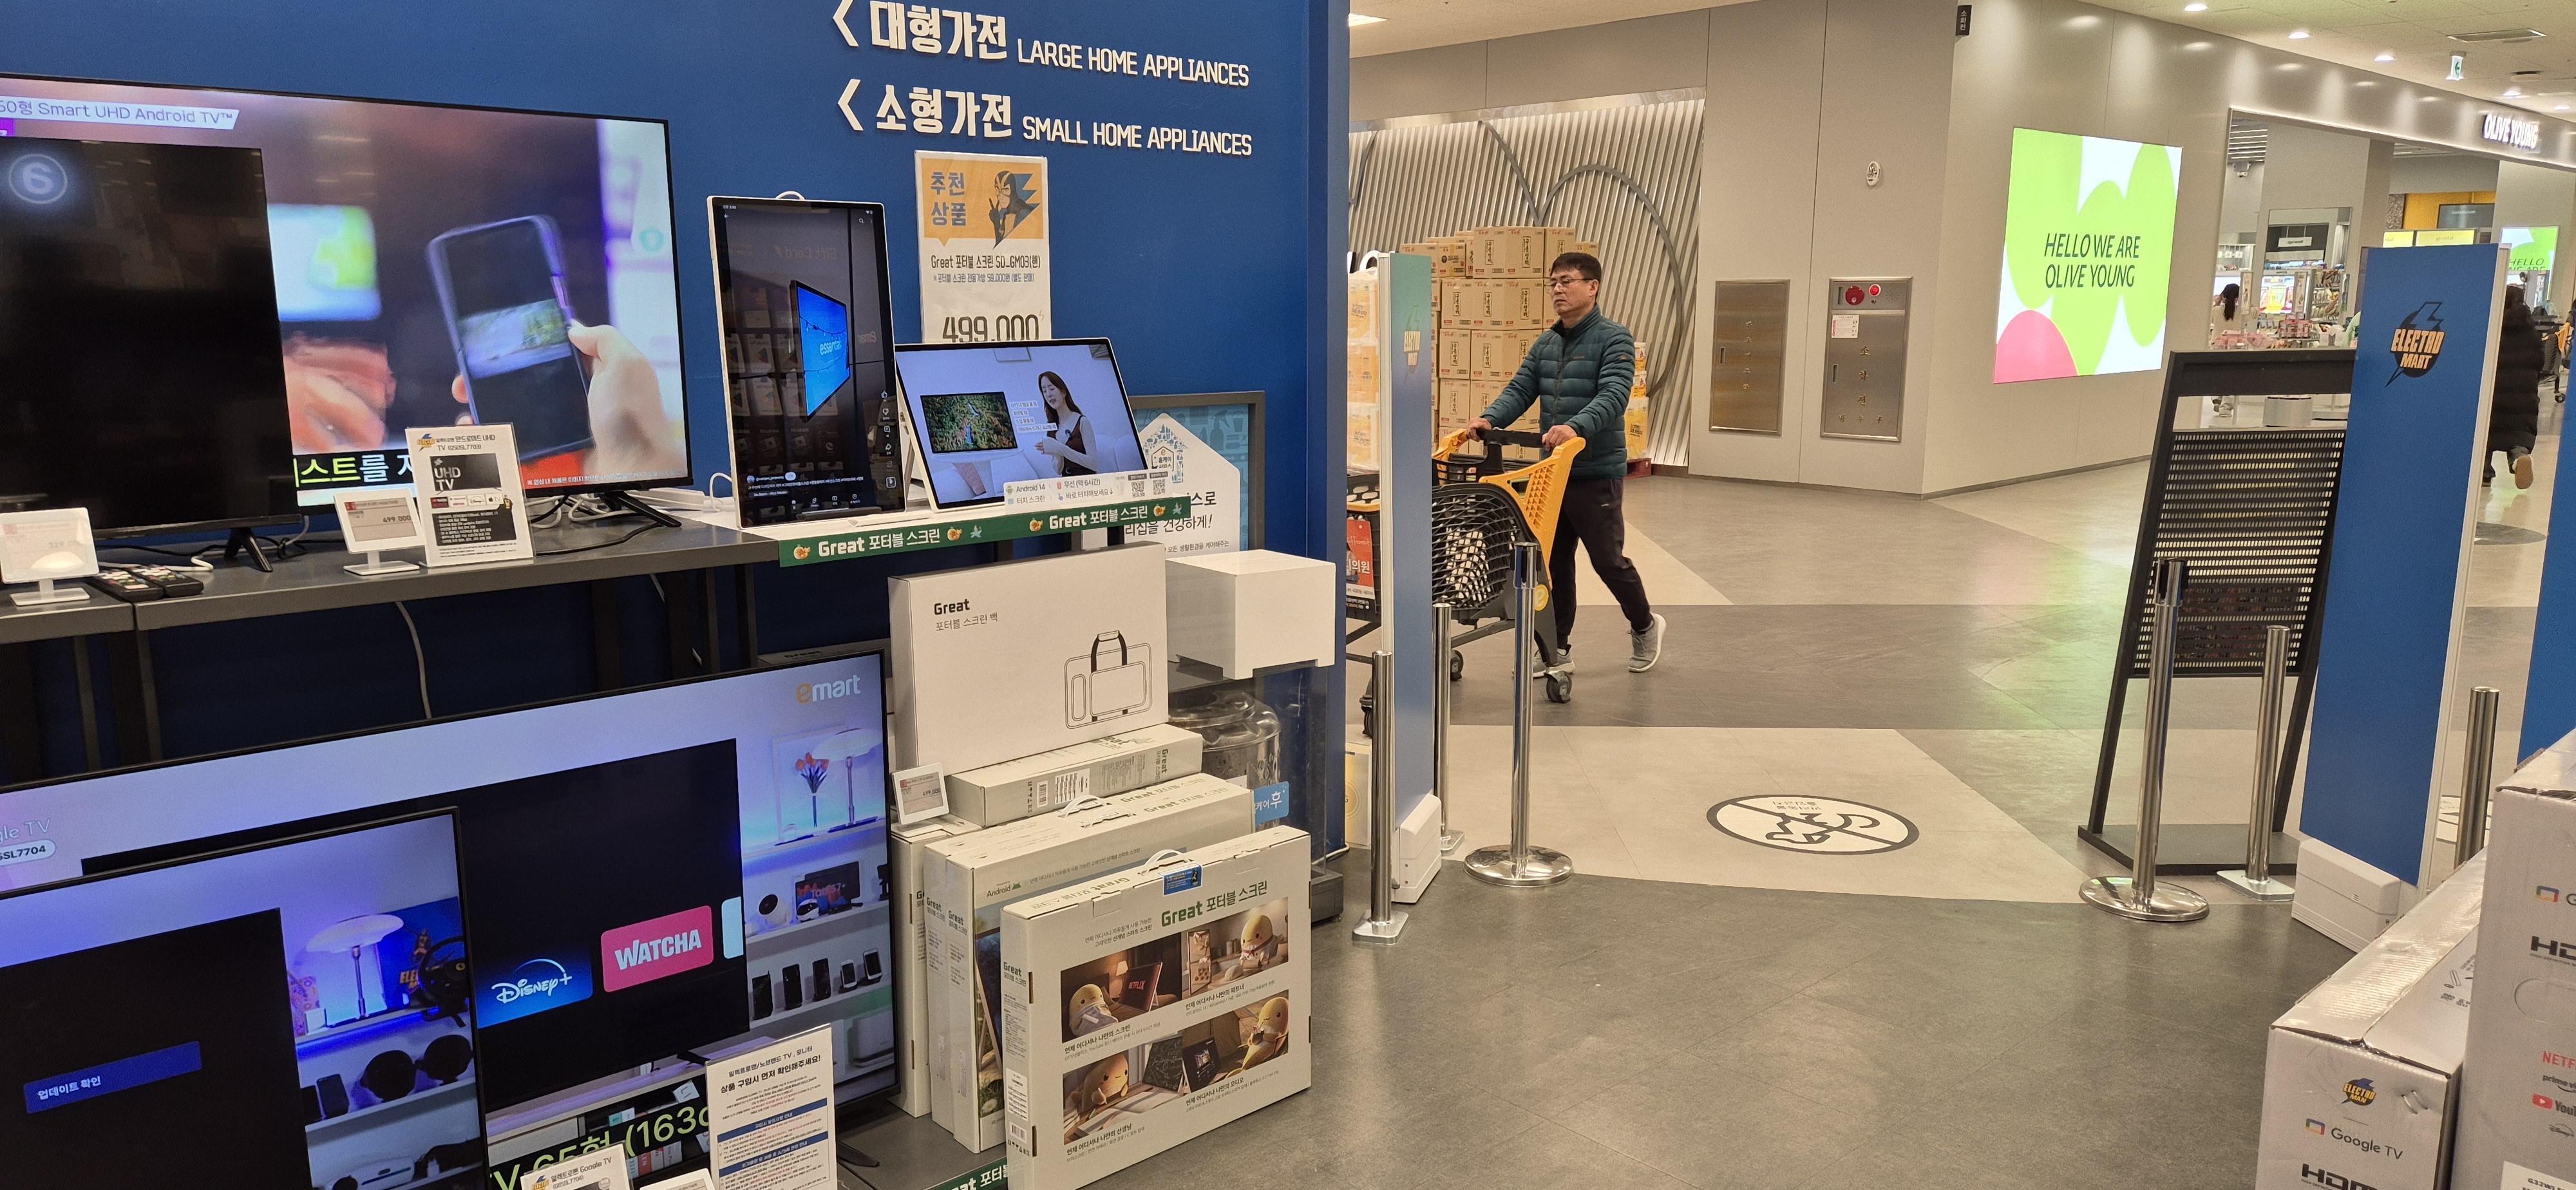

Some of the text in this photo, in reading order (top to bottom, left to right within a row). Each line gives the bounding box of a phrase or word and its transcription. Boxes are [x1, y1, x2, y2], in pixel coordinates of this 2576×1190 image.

[870, 0, 1249, 86] 대형가전 LARGE HOME APPLIANCES
[39, 102, 90, 117] Smart
[95, 106, 130, 120] UHD
[135, 108, 195, 123] Android
[876, 84, 1253, 156] 소형가전 SMALL HOME APPLIANCES
[2483, 113, 2538, 149] OLIVE YOUNG
[931, 172, 965, 196] 추천
[931, 202, 967, 227] 상품
[2044, 233, 2141, 258] HELLO WE ARE
[931, 255, 953, 269] Great
[956, 255, 974, 269] 포터블
[976, 255, 994, 269] 스크린
[2045, 264, 2135, 288] OLIVE YOUNG
[2391, 329, 2445, 354] ELECTRO
[2400, 353, 2432, 369] MART
[294, 454, 389, 487] 스트를
[434, 467, 461, 478] UHD
[435, 478, 454, 491] TV
[1016, 484, 1039, 493] Android
[1065, 480, 1075, 488] 무선
[1049, 505, 1148, 529] Great 포터블 스크린
[819, 528, 940, 557] Great 포터블 스크린
[934, 598, 971, 616] Great
[936, 612, 999, 631] 포터블 스크린 백
[796, 675, 861, 704] emart
[1120, 791, 1155, 802] Great
[1144, 802, 1180, 813] Great
[24, 818, 50, 835] TV
[987, 885, 1010, 898] Android
[1094, 877, 1130, 891] Great
[927, 897, 942, 912] Great
[1161, 880, 1267, 927] Great 포터블 스크린
[949, 910, 963, 925] Great
[1139, 923, 1152, 933] 스크린
[615, 929, 701, 970] WATCHA
[1003, 962, 1021, 977] Great
[491, 973, 572, 1003] Disney+
[1128, 980, 1146, 990] NETFLIX
[1065, 1025, 1130, 1054] 언제 어디서나 나만의 스크린
[797, 1046, 813, 1055] 모니터
[721, 1055, 820, 1093] 상품 구입시 먼저 확인해주세요!
[1231, 1077, 1244, 1086] 오디오
[2543, 1075, 2568, 1086] prime
[37, 1075, 100, 1100] 업데이트 확인
[2343, 1083, 2376, 1100] ELECTRO
[2350, 1094, 2367, 1103] MAN
[1079, 1137, 1099, 1149] 어디서나
[2331, 1128, 2403, 1159] Google TV
[580, 1162, 601, 1173] Google
